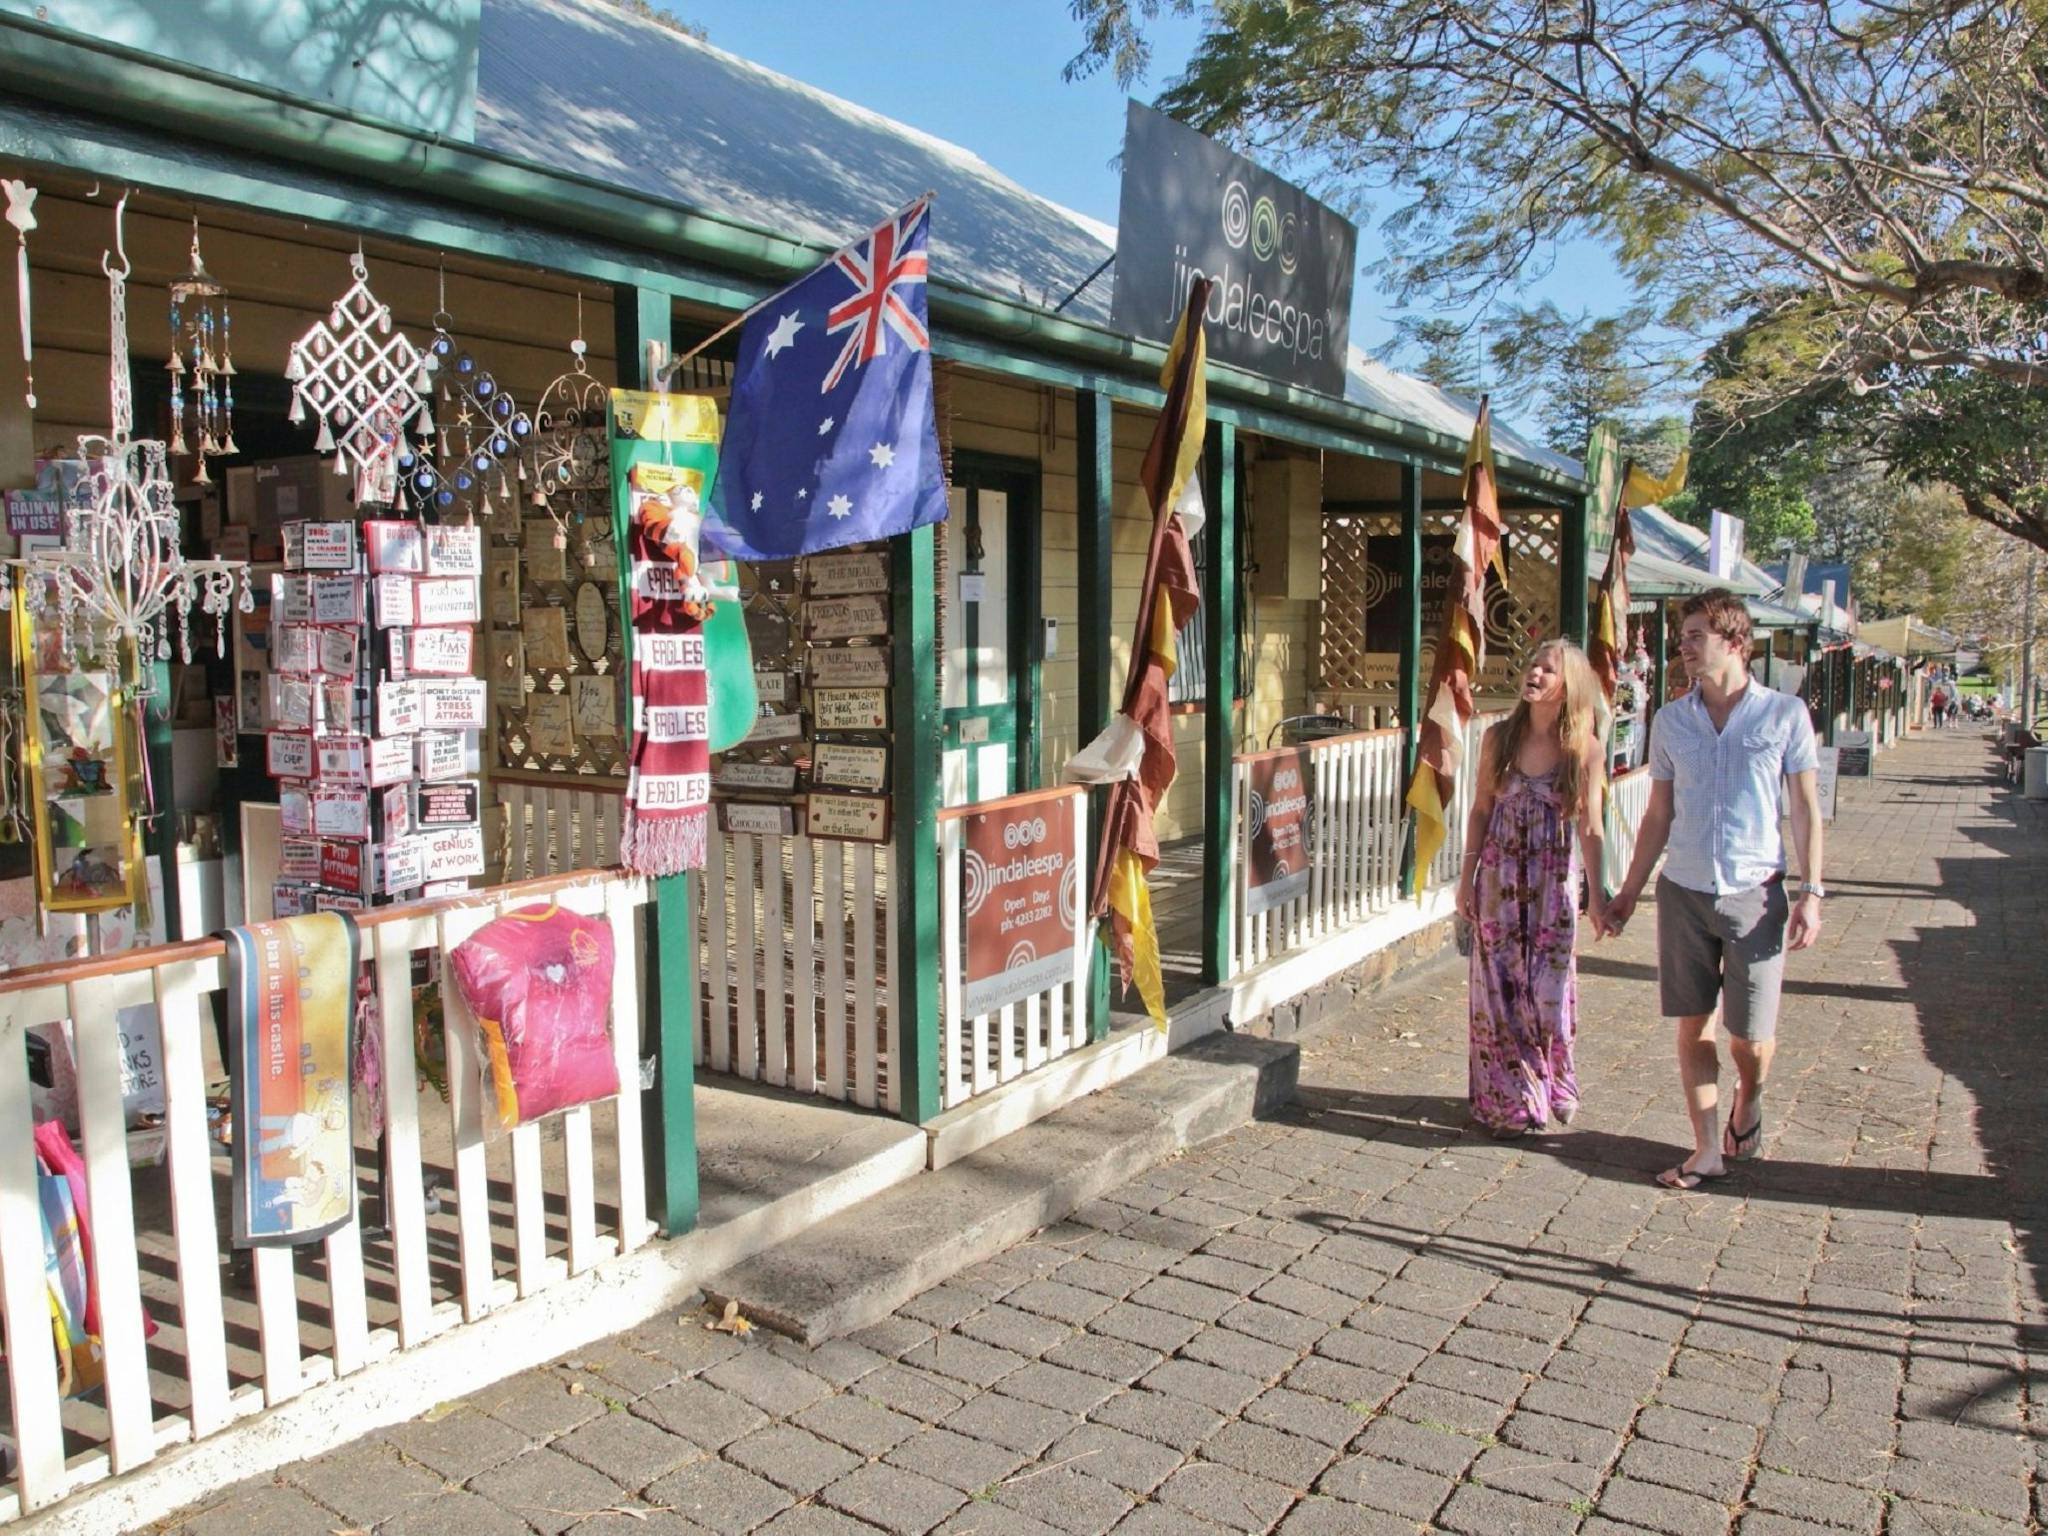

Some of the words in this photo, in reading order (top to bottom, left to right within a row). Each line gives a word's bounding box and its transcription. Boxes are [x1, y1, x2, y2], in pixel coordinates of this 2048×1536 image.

[12, 516, 27, 530] IN
[30, 514, 57, 530] USE
[646, 566, 680, 594] EAGL
[857, 577, 880, 589] WINE
[853, 607, 879, 623] WINE
[652, 638, 704, 667] EAGLES
[854, 660, 881, 673] WINE
[436, 701, 472, 710] STRESS
[434, 711, 474, 720] ATTACK
[654, 710, 706, 737] EAGLES
[645, 778, 705, 805] EAGLES
[433, 838, 474, 853] GENIUS
[430, 858, 443, 870] AT
[445, 853, 480, 867] WORK
[987, 852, 1064, 895] jindaleespa
[1004, 897, 1026, 915] Open
[265, 939, 281, 969] bar
[269, 974, 284, 991] is
[270, 993, 285, 1020] his
